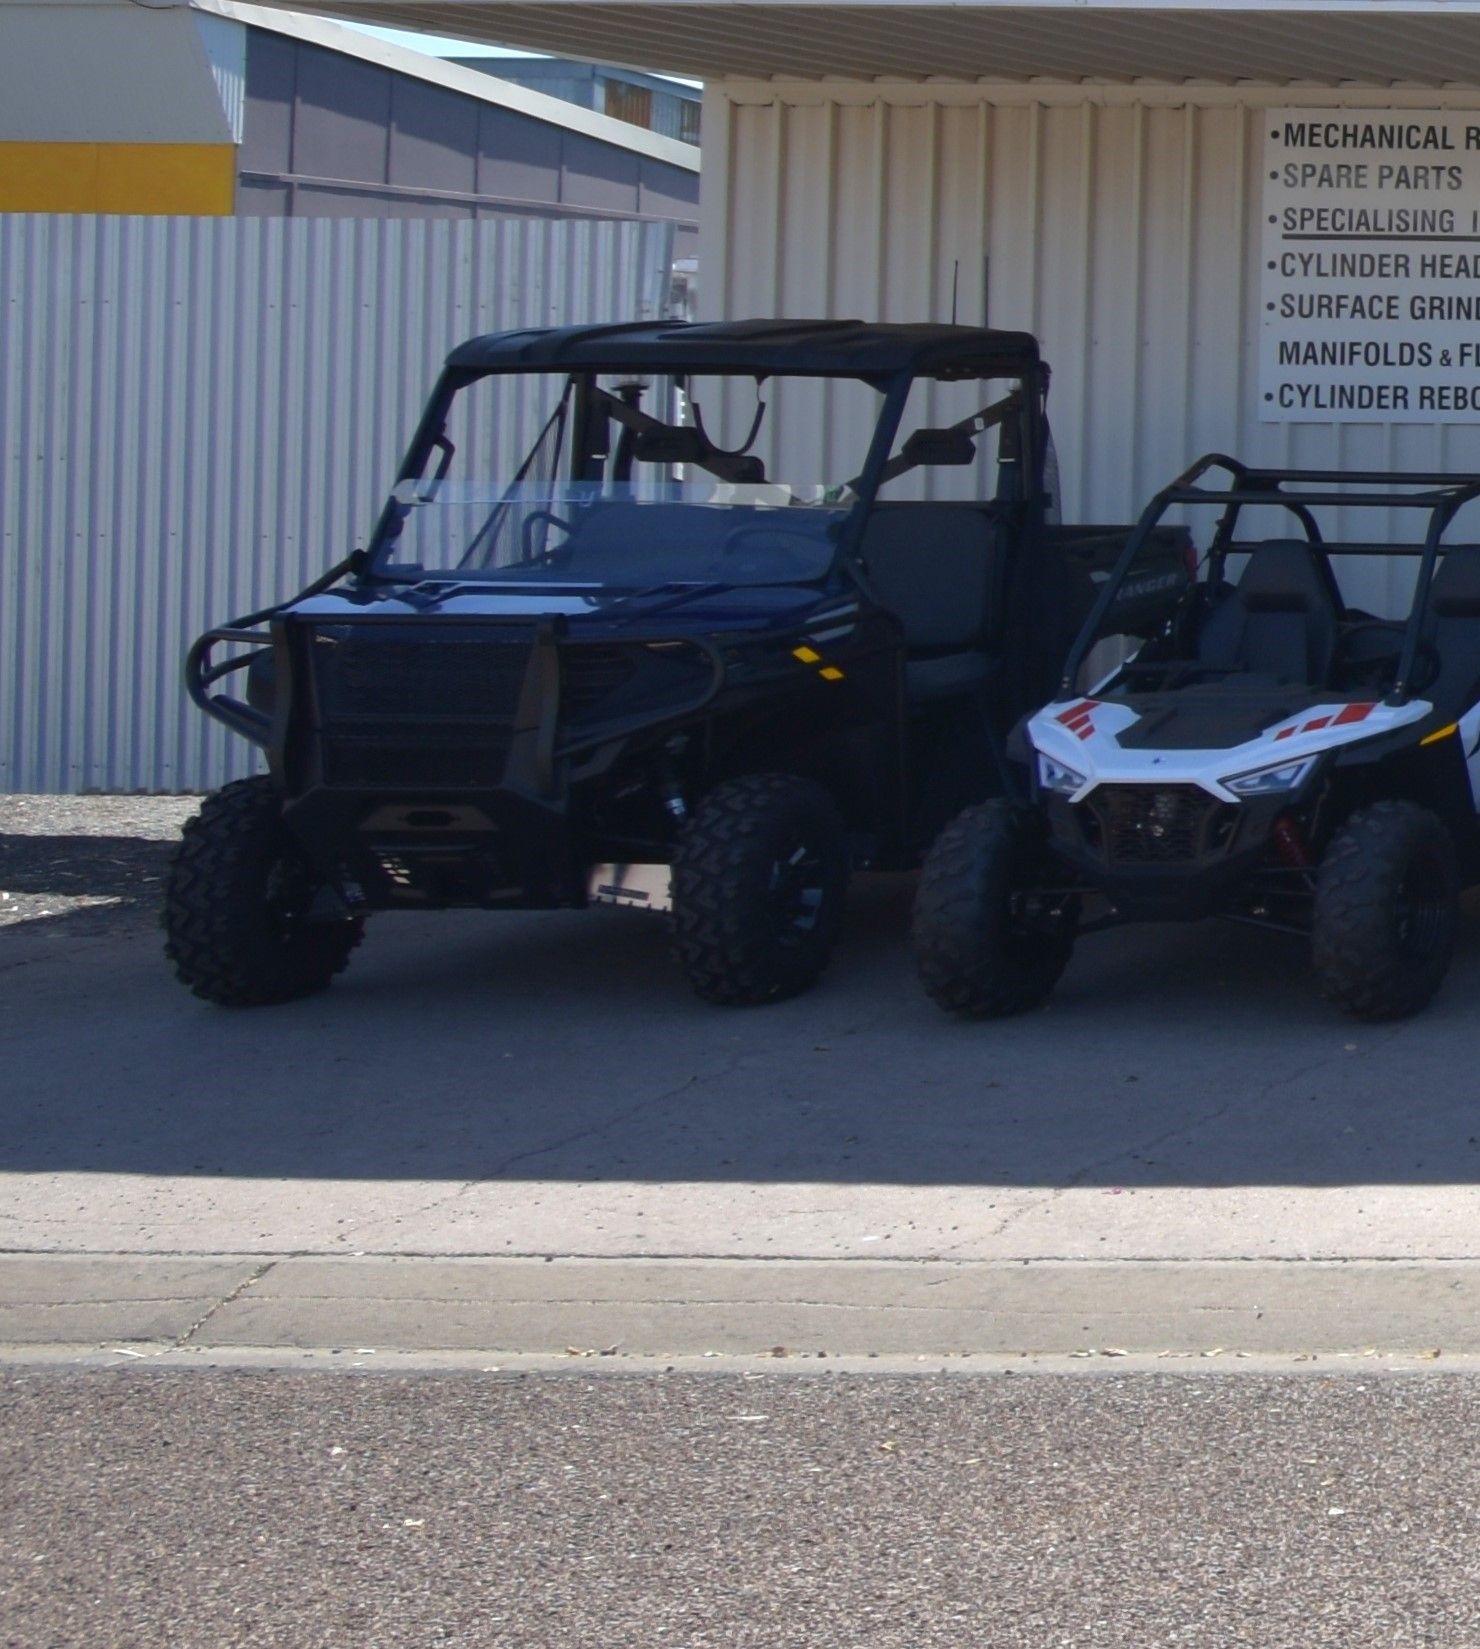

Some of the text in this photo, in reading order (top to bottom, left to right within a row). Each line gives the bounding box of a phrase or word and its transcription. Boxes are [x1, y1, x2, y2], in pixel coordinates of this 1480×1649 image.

[1285, 123, 1455, 149] MECHANICAL
[1284, 163, 1462, 190] SPARE PARTS
[1283, 207, 1454, 232] SPECIALISING
[1281, 253, 1410, 278] CYLINDER
[1281, 294, 1399, 319] SURFACE
[1280, 342, 1432, 367] MANIFOLDS
[1440, 350, 1451, 366] &
[1279, 383, 1408, 409] CYLINDER
